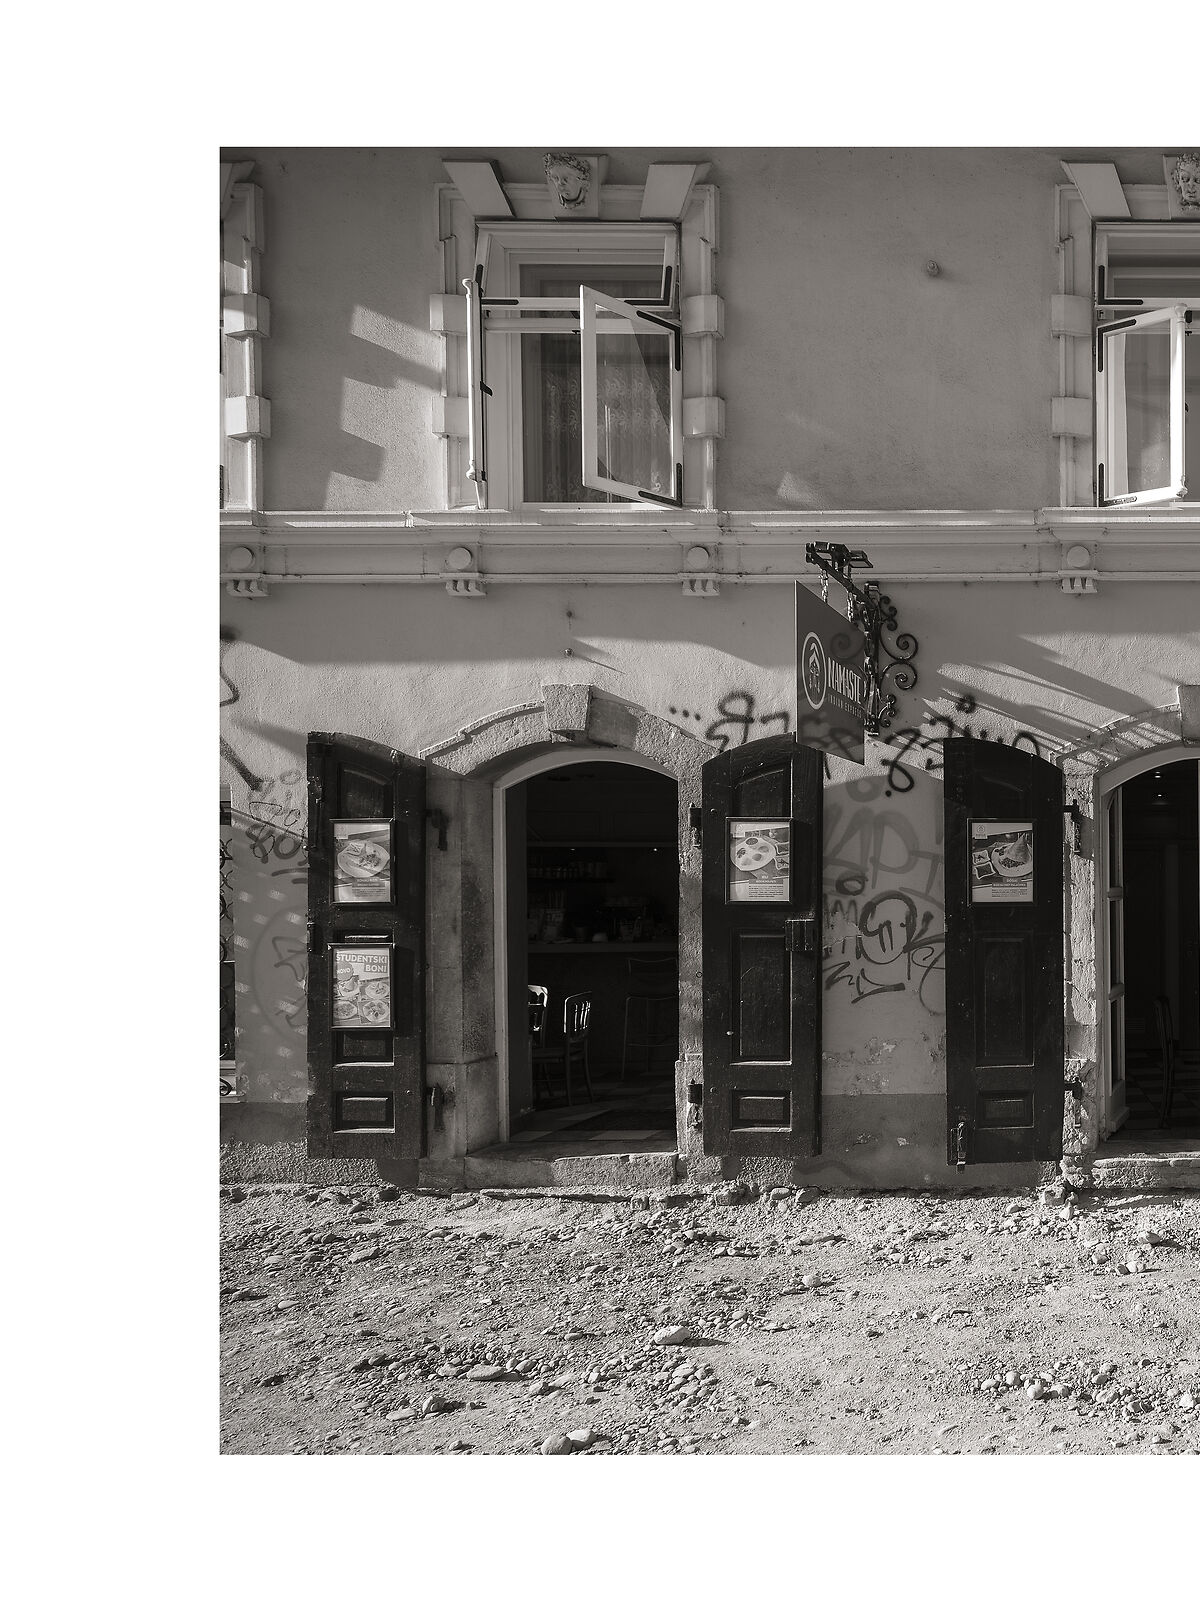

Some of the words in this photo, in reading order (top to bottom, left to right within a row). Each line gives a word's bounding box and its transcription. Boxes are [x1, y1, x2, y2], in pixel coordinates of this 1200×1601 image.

[828, 657, 862, 704] NAMASTE
[336, 953, 388, 964] STUDENTSKI
[365, 964, 387, 972] BONI
